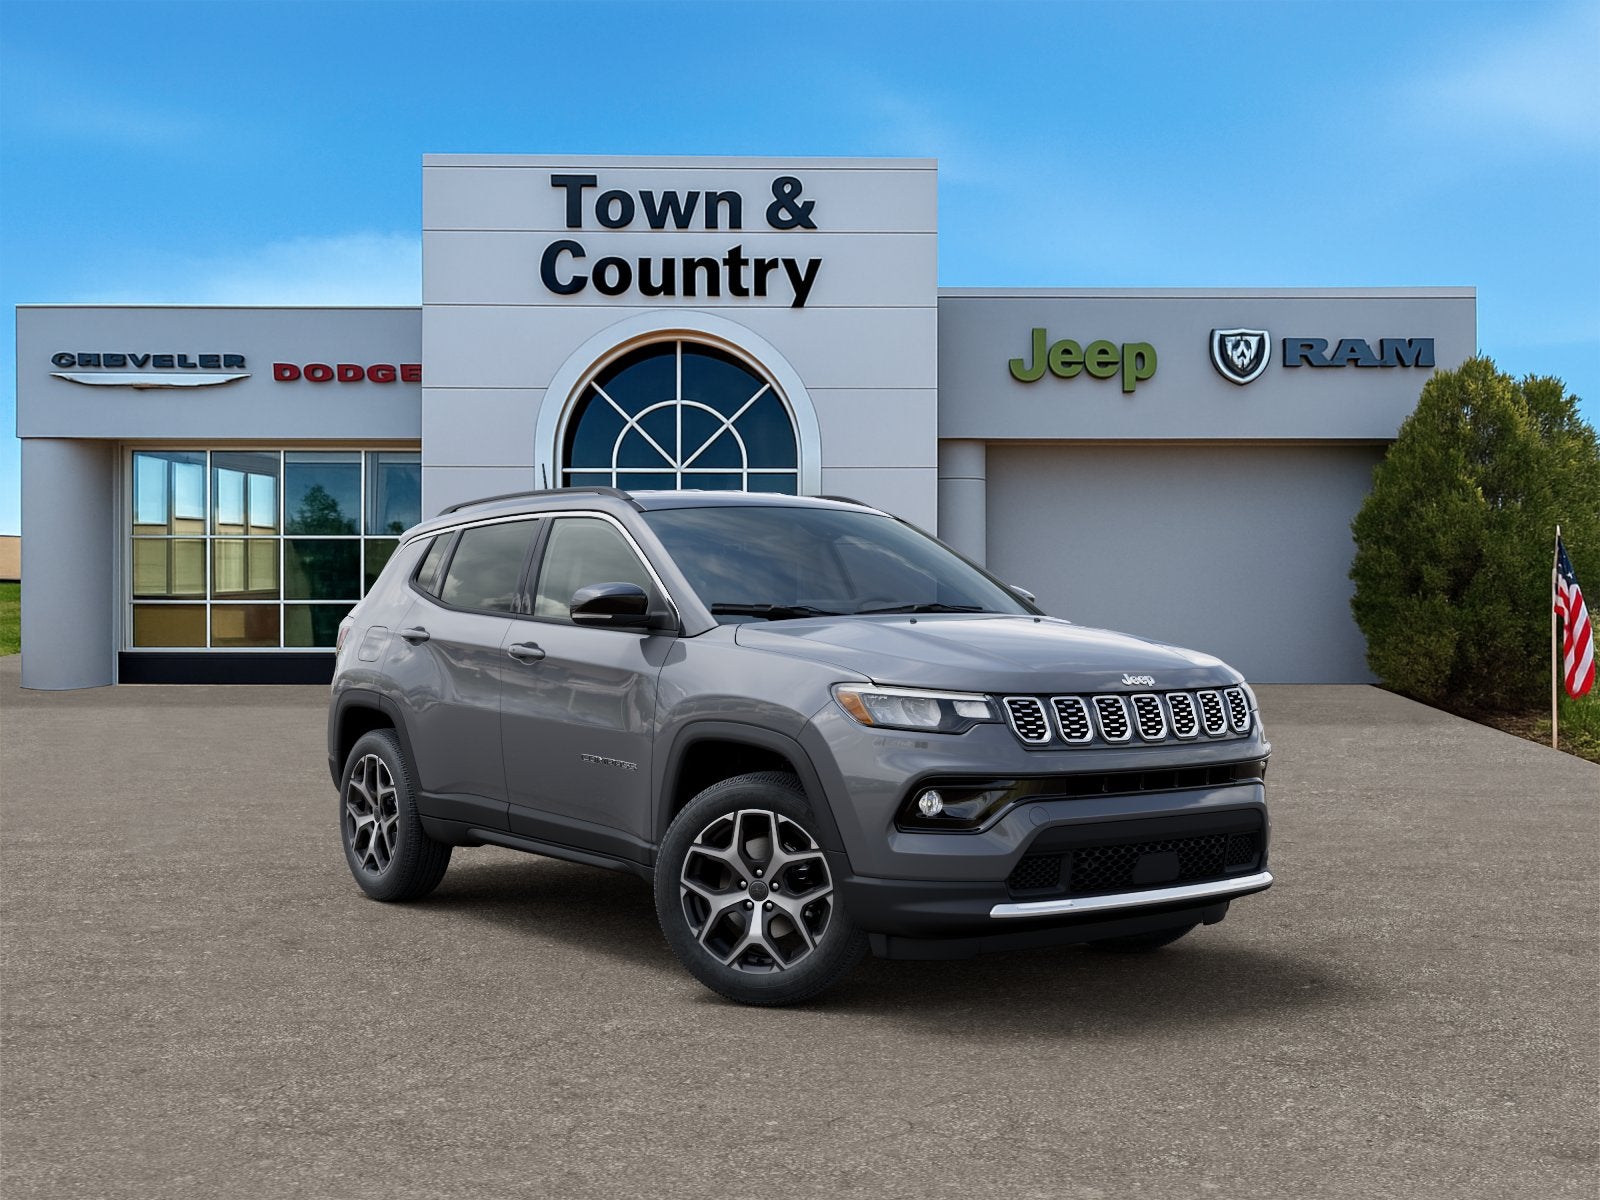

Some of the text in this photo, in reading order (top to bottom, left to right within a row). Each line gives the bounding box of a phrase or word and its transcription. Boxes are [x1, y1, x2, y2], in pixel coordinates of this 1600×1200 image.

[550, 174, 818, 230] Town &
[540, 239, 822, 308] Country
[273, 362, 422, 384] DODGE
[1009, 328, 1157, 393] Jeep
[1283, 337, 1436, 368] RAM
[1121, 673, 1156, 687] Jeep
